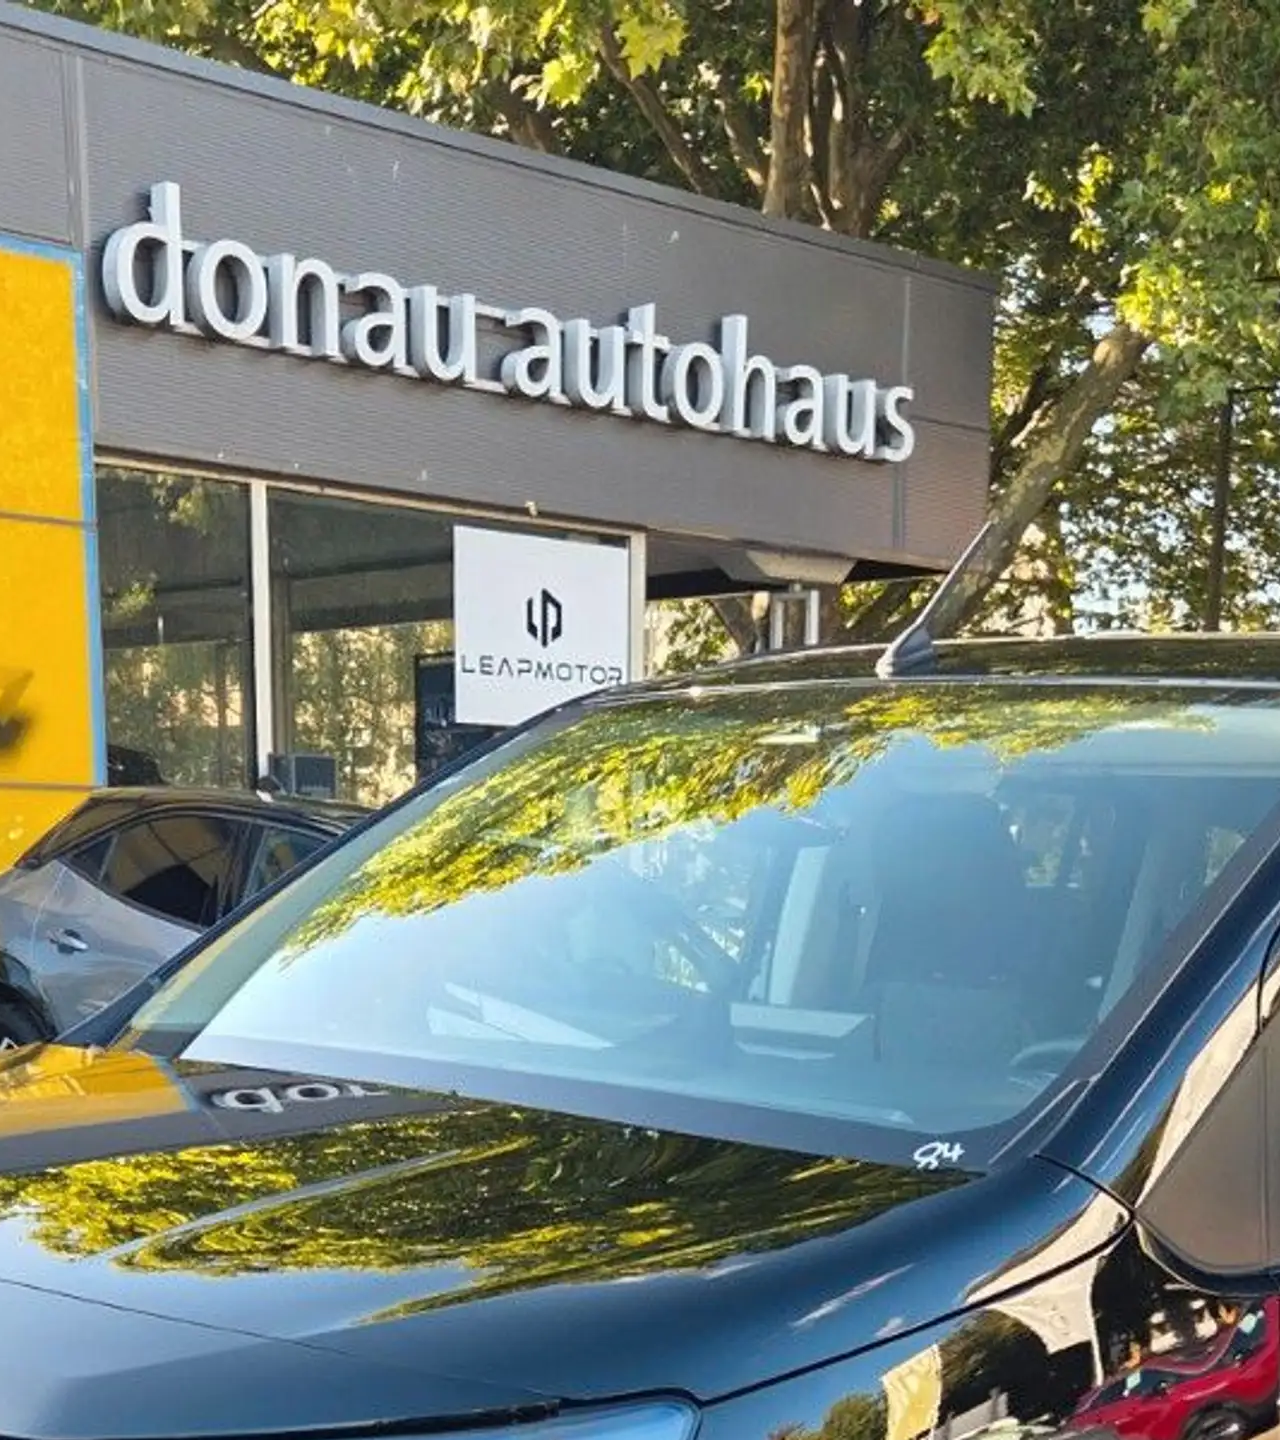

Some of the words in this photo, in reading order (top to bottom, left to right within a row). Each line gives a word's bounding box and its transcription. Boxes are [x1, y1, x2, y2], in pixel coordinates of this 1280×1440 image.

[102, 181, 476, 384] donau
[500, 301, 917, 463] autohaus
[461, 655, 622, 685] LEAPMOTOR
